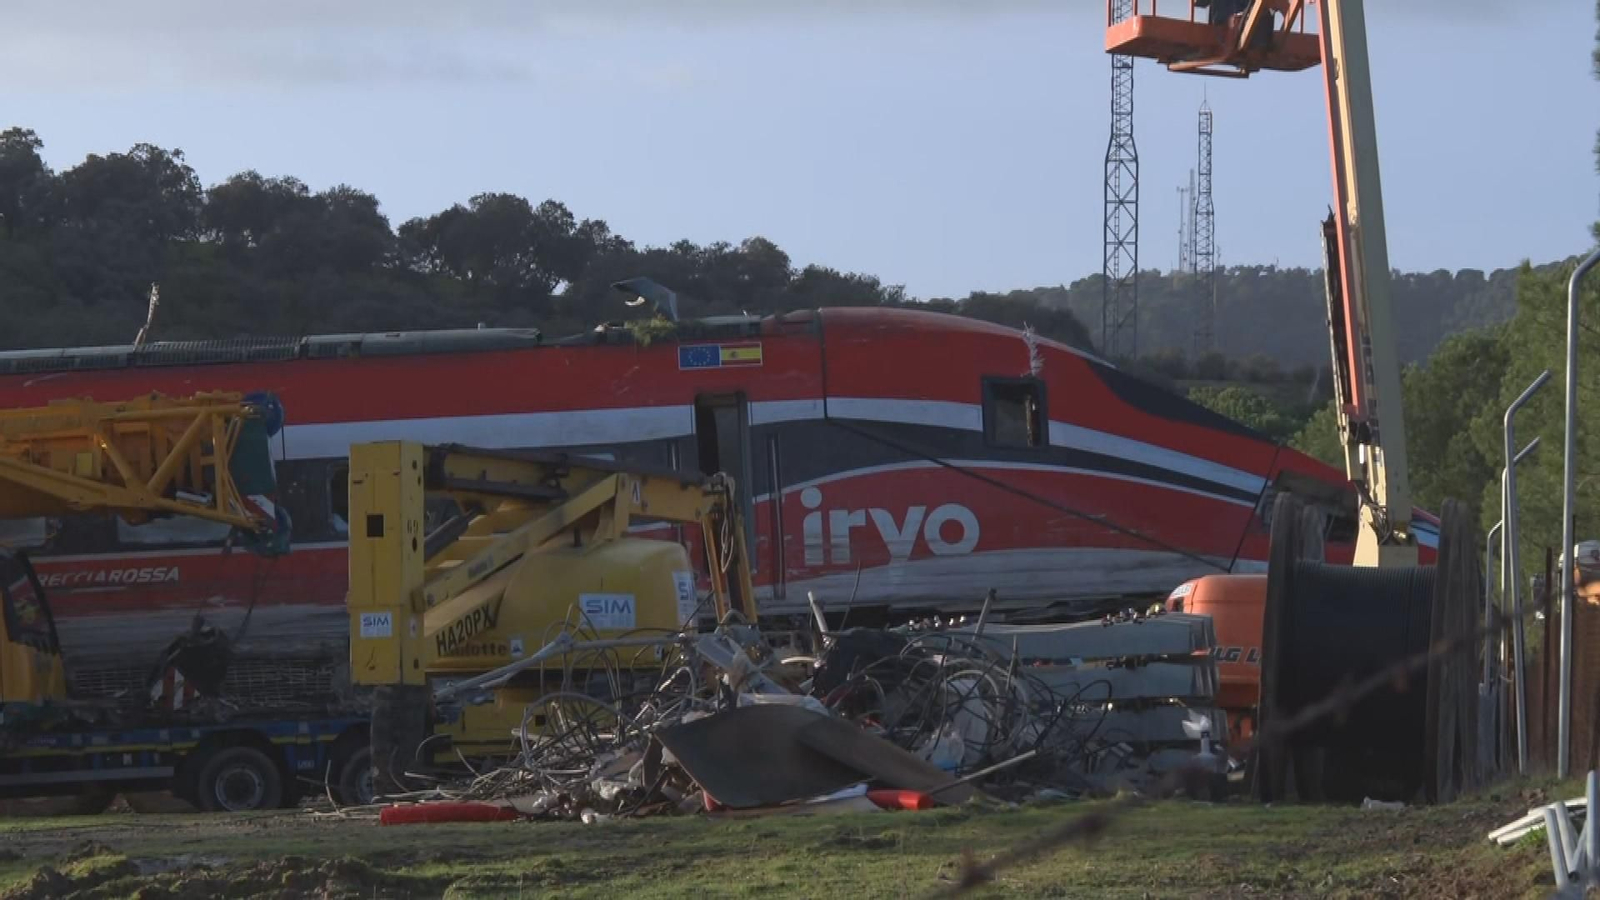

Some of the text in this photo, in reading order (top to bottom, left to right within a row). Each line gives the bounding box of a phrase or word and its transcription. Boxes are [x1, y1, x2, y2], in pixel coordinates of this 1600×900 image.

[801, 486, 980, 570] iryo
[37, 566, 179, 587] RECCIAROSSA
[586, 599, 632, 614] SIM
[363, 616, 389, 627] SIM
